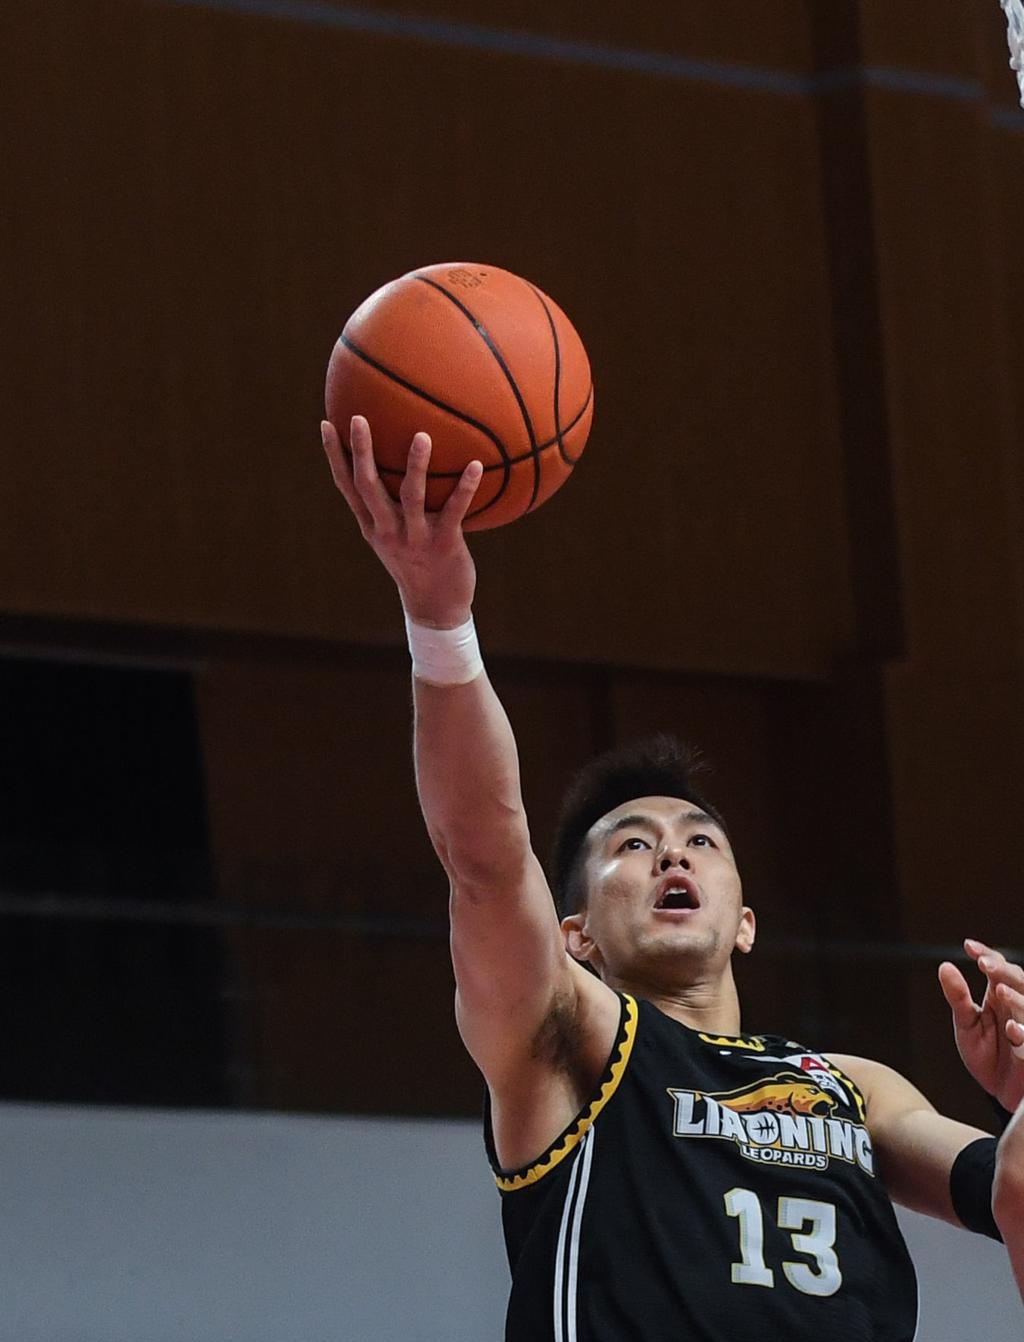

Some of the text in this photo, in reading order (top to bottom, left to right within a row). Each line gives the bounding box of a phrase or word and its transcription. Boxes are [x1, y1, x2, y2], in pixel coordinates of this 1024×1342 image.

[673, 1090, 875, 1178] LIAONING
[743, 1146, 827, 1168] LEOPARDS
[723, 1187, 843, 1297] 13
